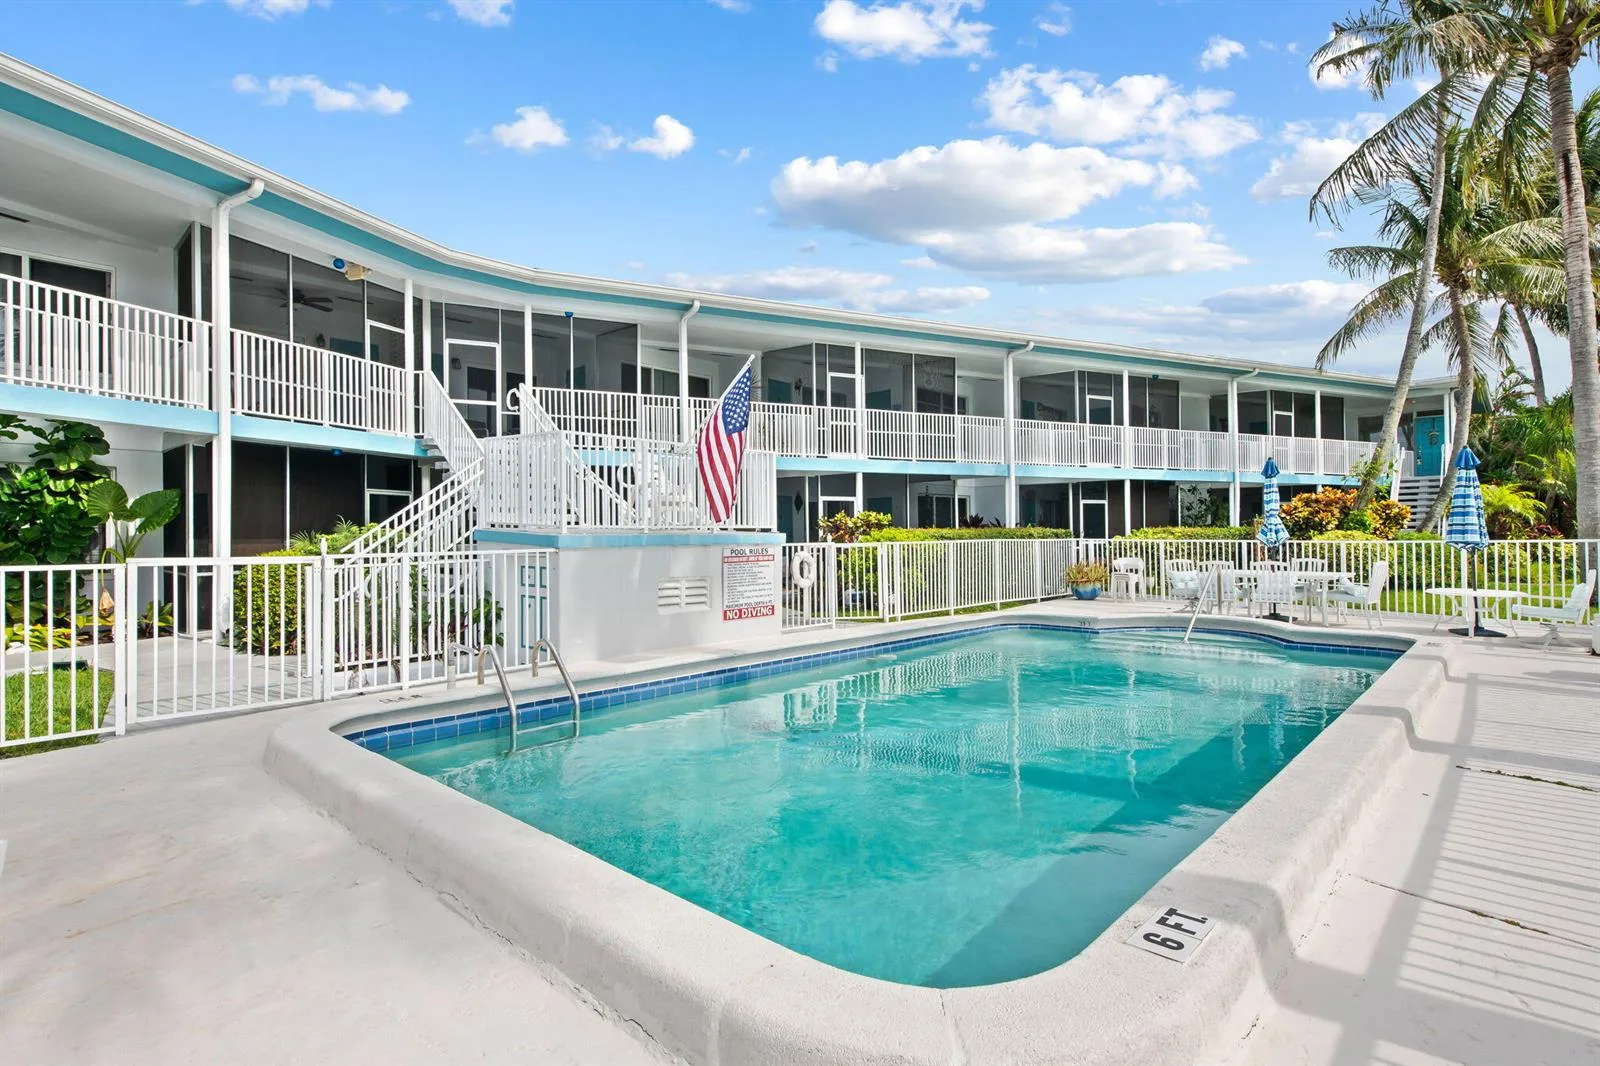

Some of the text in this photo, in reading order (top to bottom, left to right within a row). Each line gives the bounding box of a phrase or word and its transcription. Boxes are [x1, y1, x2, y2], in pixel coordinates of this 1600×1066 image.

[749, 547, 769, 555] RULES
[726, 606, 773, 620] NO DIVING
[1143, 907, 1208, 950] 6 FT.
